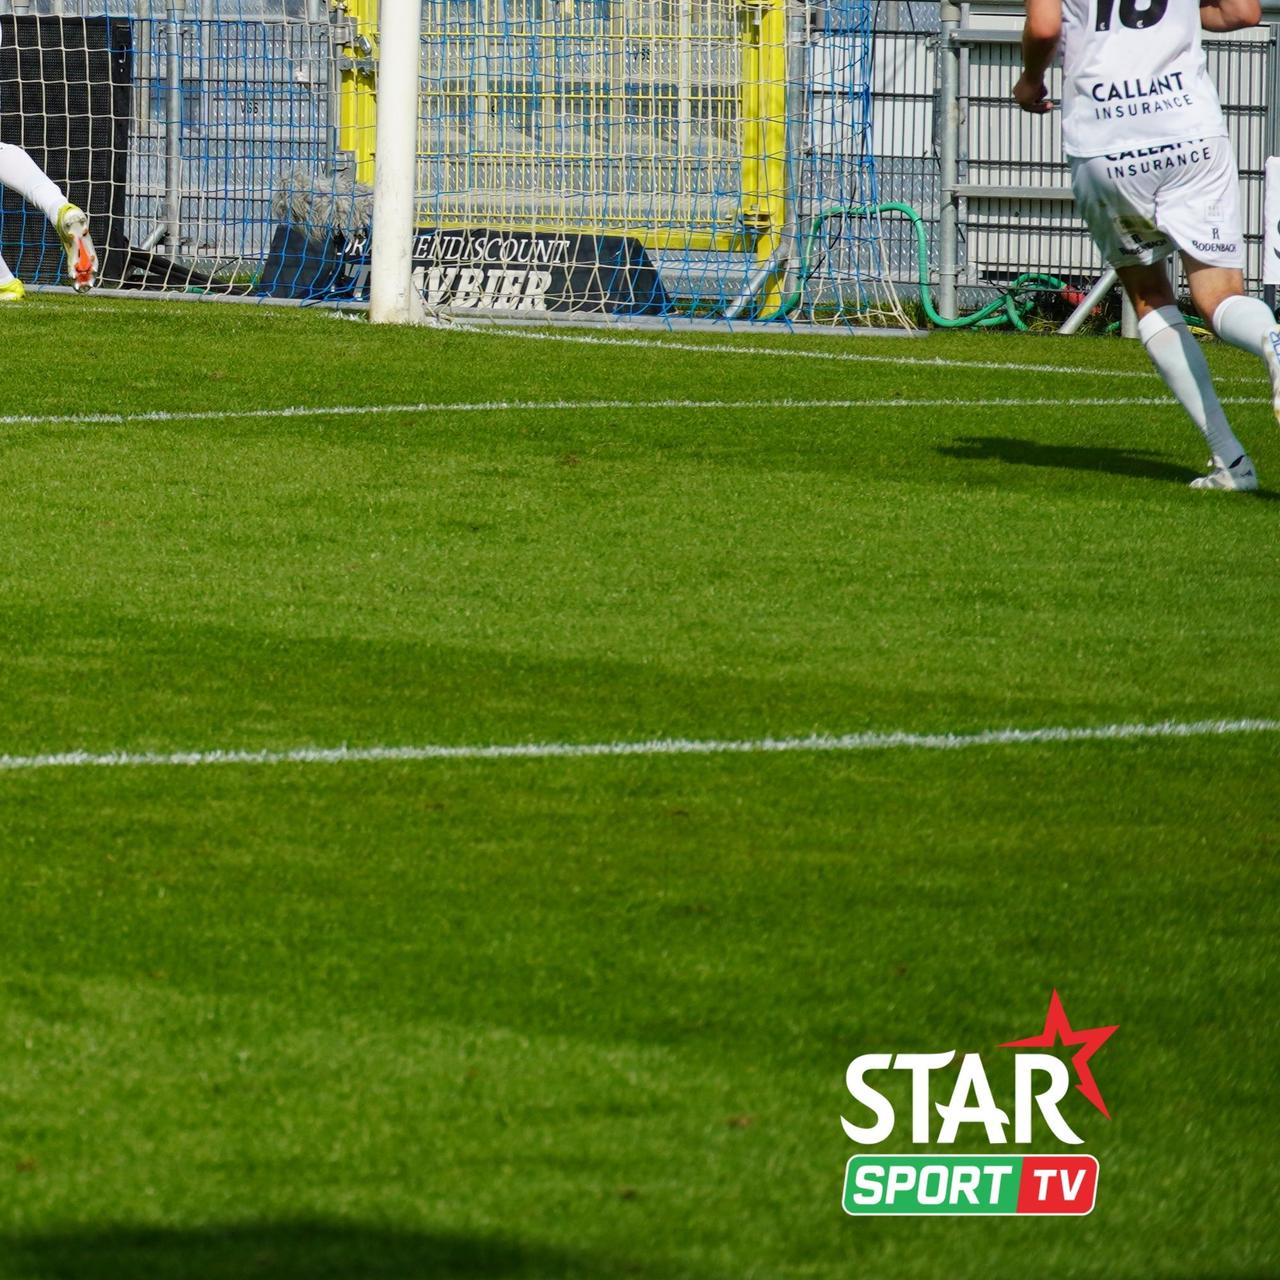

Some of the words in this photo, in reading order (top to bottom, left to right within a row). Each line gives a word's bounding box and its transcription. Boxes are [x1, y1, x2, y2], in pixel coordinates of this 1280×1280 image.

[1092, 72, 1185, 102] CALLANT
[1095, 94, 1193, 120] INSURANCE
[1107, 147, 1211, 179] INSURANCE
